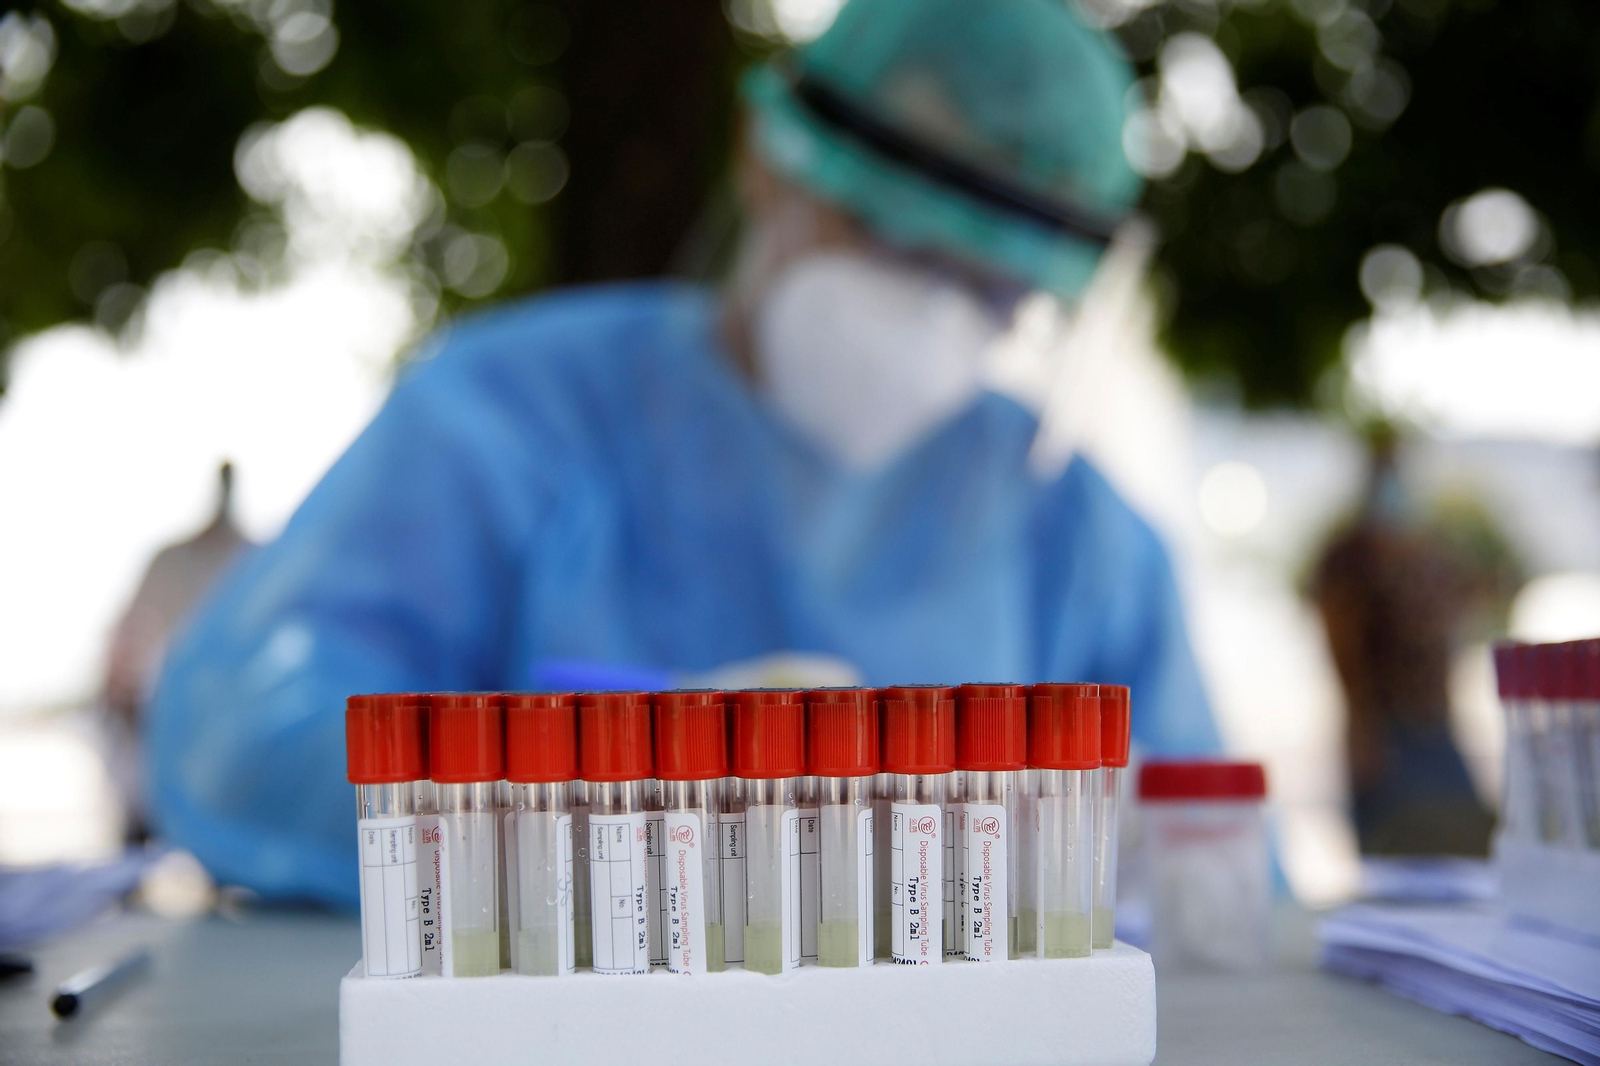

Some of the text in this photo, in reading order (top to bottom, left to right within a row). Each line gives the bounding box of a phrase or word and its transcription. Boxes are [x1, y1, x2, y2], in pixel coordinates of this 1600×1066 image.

[807, 819, 815, 833] Date
[729, 824, 738, 857] Sampling unit
[677, 850, 687, 890] Disposable
[918, 841, 929, 880] Disposable
[421, 888, 432, 914] Type
[636, 885, 644, 912] Type
[670, 886, 678, 912] Type
[679, 890, 688, 910] Virus
[907, 876, 919, 903] Type
[920, 880, 929, 900] Virus
[973, 876, 982, 902] Type
[981, 841, 993, 956] Disposable Virus Sampling Tube
[680, 911, 690, 946] Sampling
[909, 922, 920, 941] 2ml
[918, 901, 929, 936] Sampling
[973, 921, 983, 939] 2ml
[424, 933, 435, 952] 2ml
[638, 932, 646, 951] 2ml
[672, 932, 680, 950] 2ml
[920, 938, 930, 956] Tube
[683, 948, 691, 967] Tube
